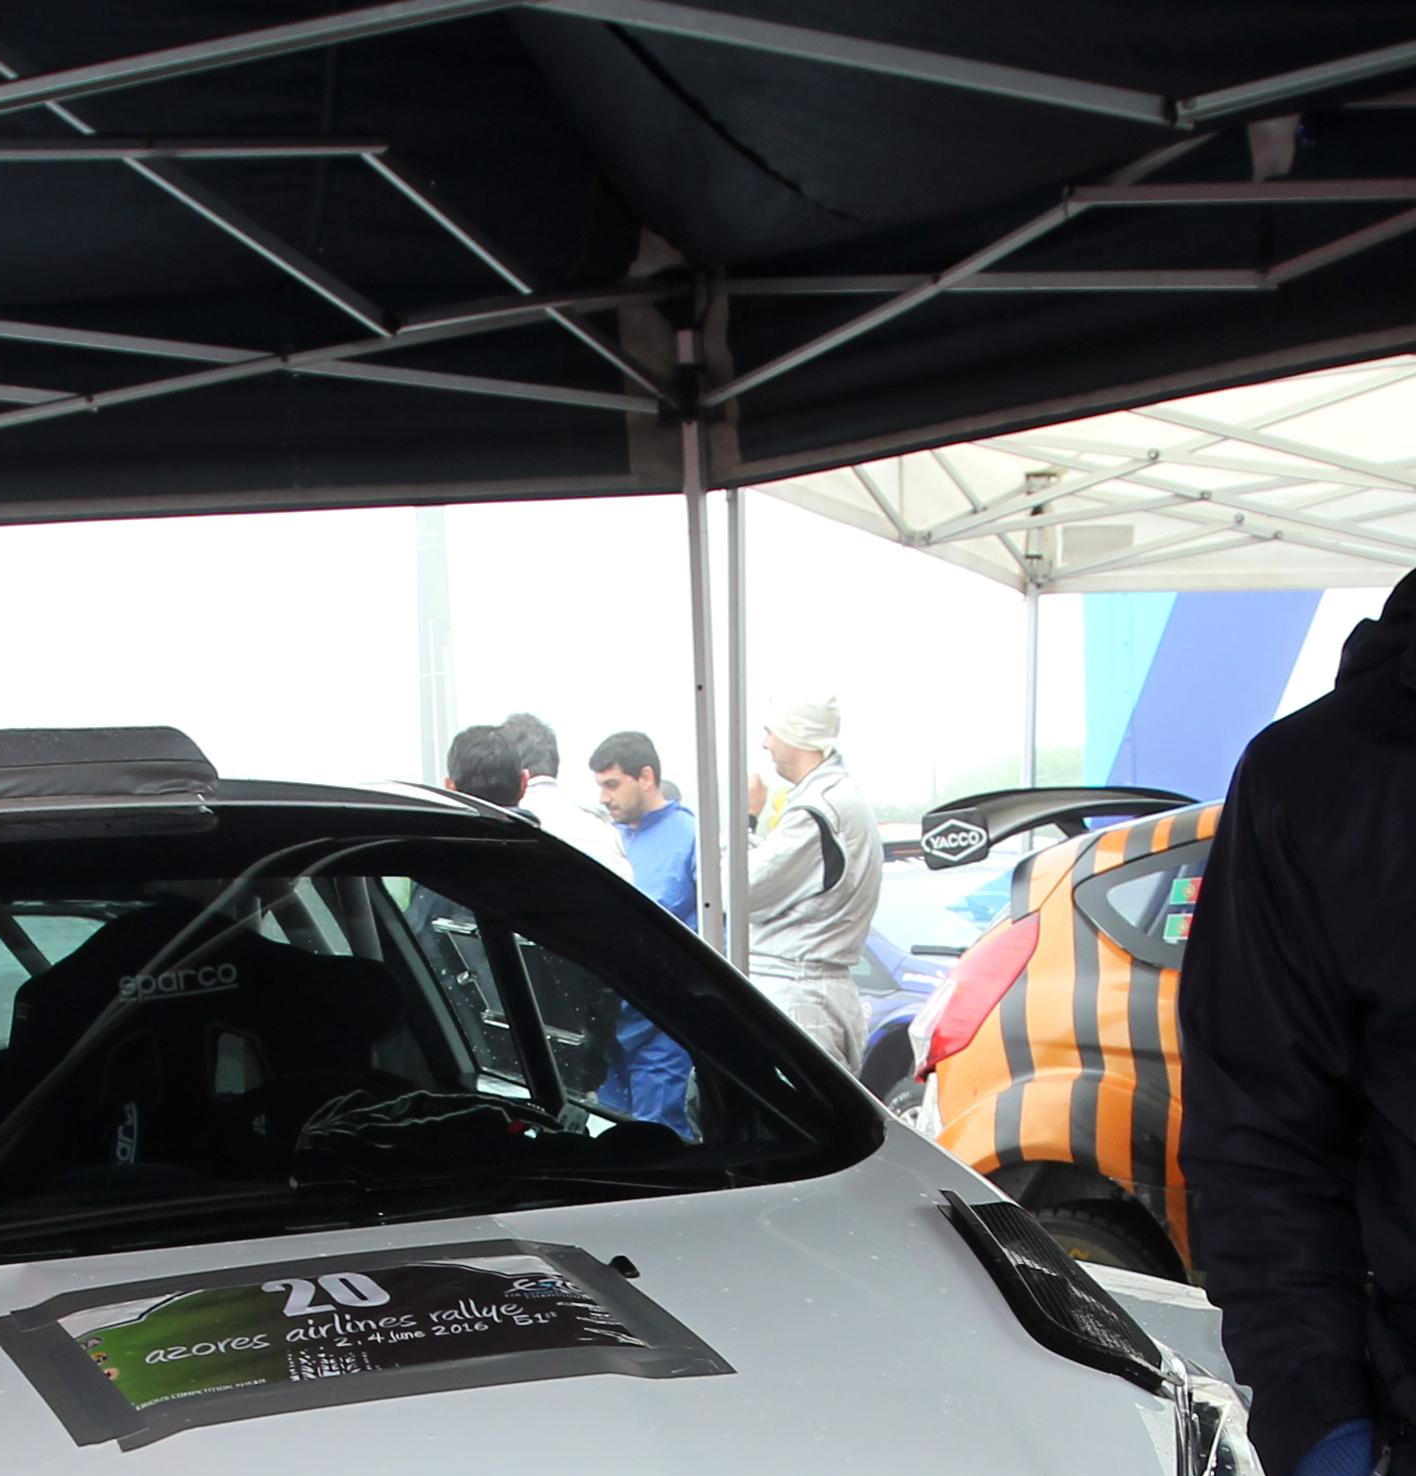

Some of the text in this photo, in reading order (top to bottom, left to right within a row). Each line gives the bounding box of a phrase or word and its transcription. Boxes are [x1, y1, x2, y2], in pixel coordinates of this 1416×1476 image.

[930, 831, 980, 850] YACCO
[119, 963, 237, 1002] sparco
[261, 1272, 390, 1318] 20
[145, 1298, 524, 1365] azores airlines rallye
[387, 1328, 426, 1343] June
[432, 1321, 489, 1337] 2016
